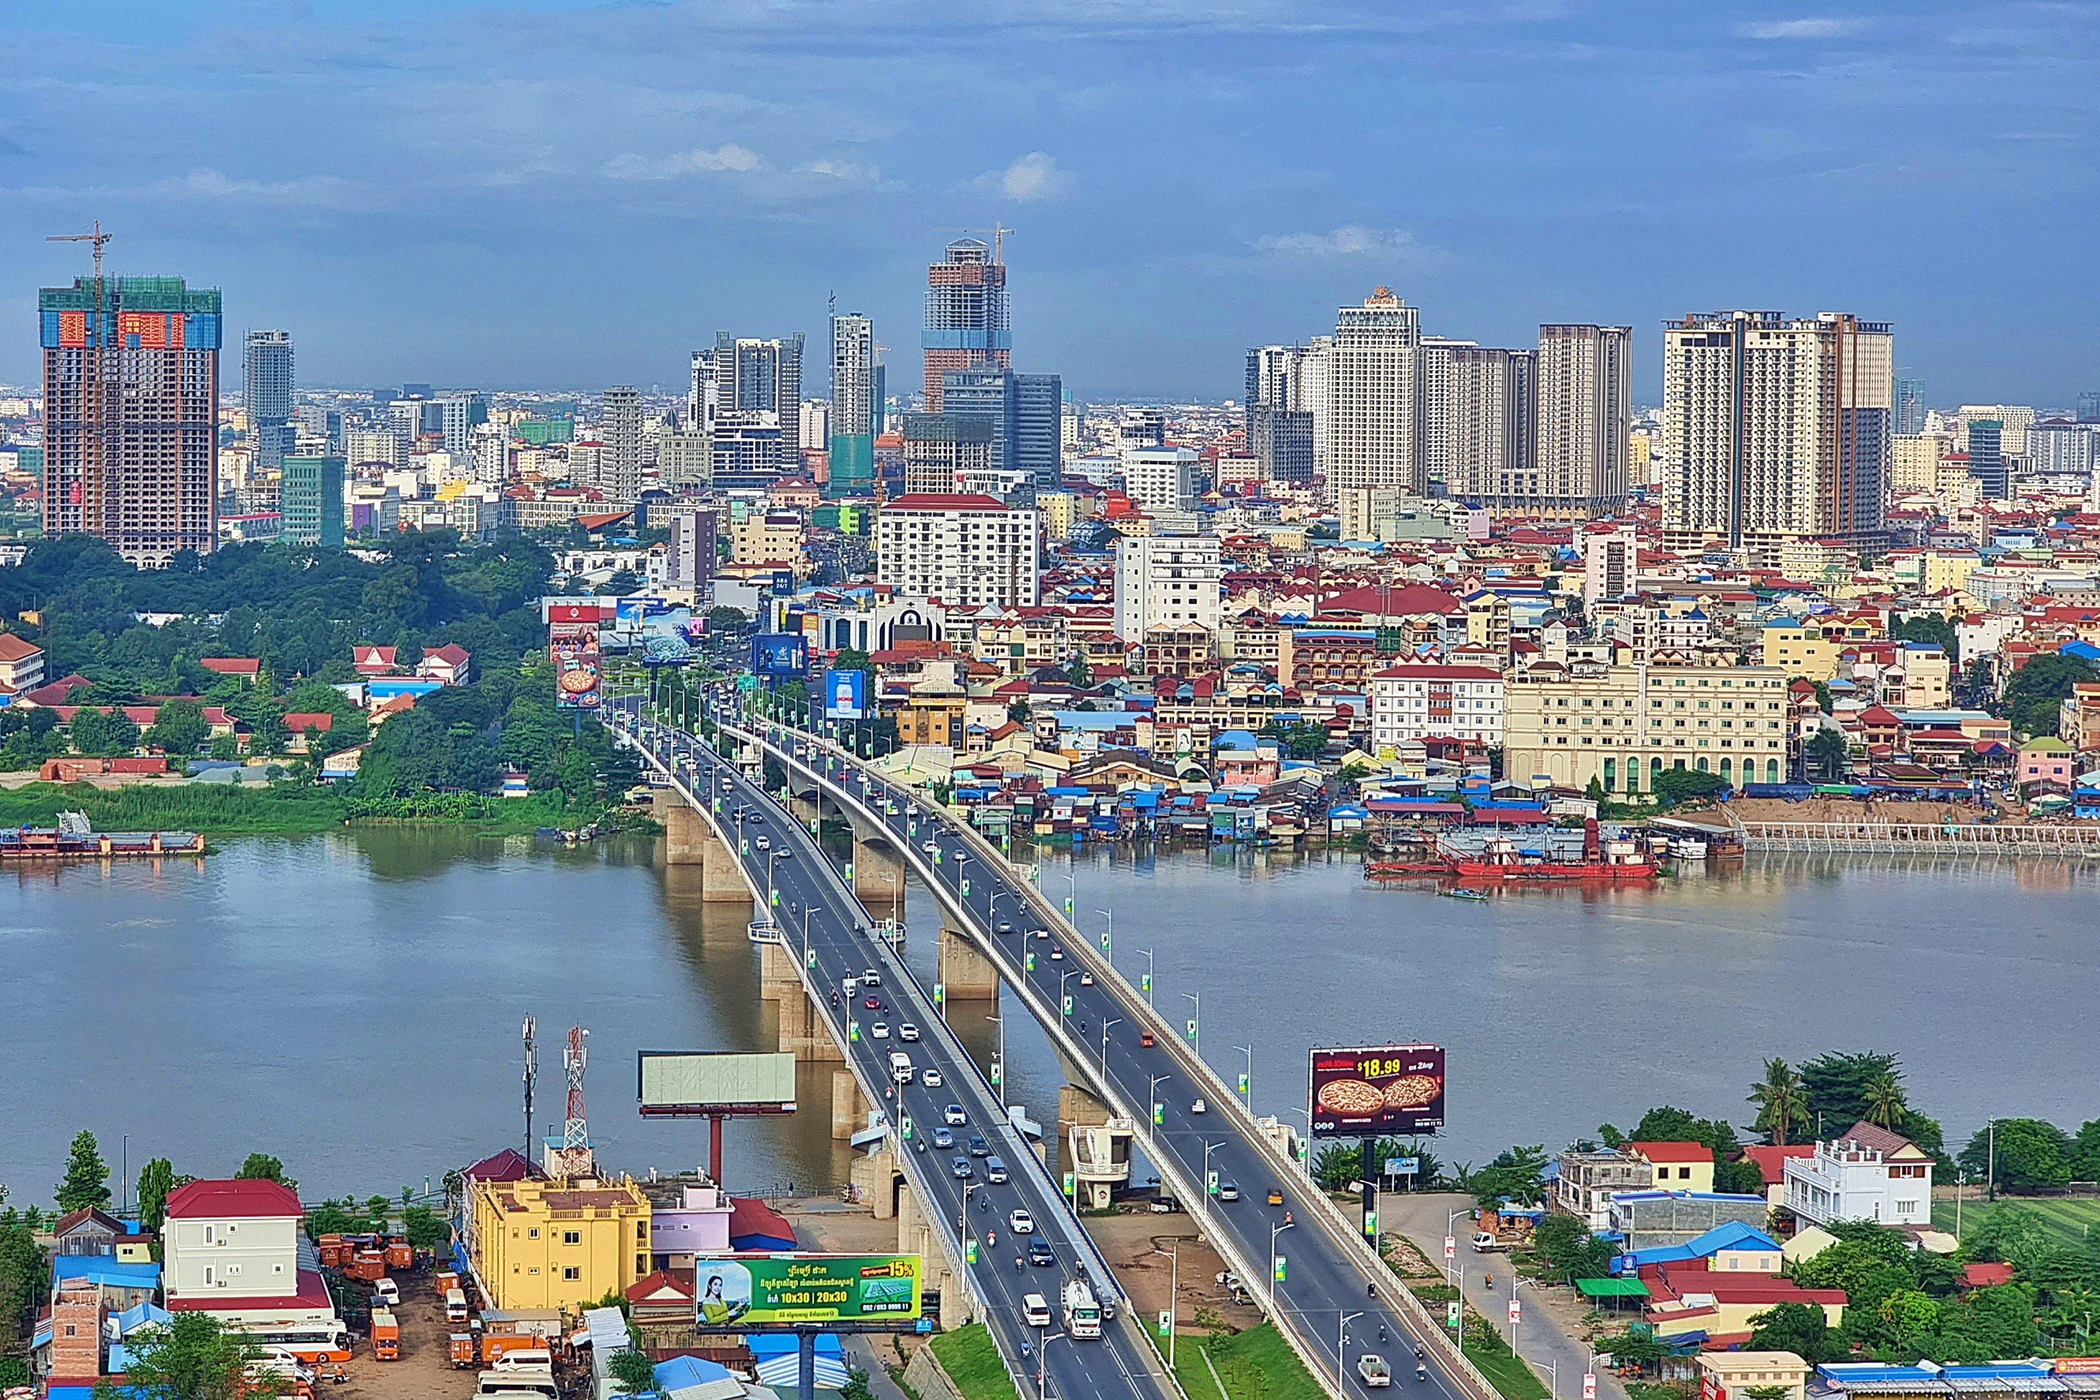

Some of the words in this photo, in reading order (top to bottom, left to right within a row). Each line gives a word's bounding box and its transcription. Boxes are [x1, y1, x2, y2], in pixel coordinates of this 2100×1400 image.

[888, 1261, 914, 1277] 15%
[781, 1292, 810, 1304] 10x30
[816, 1291, 848, 1303] 20x30
